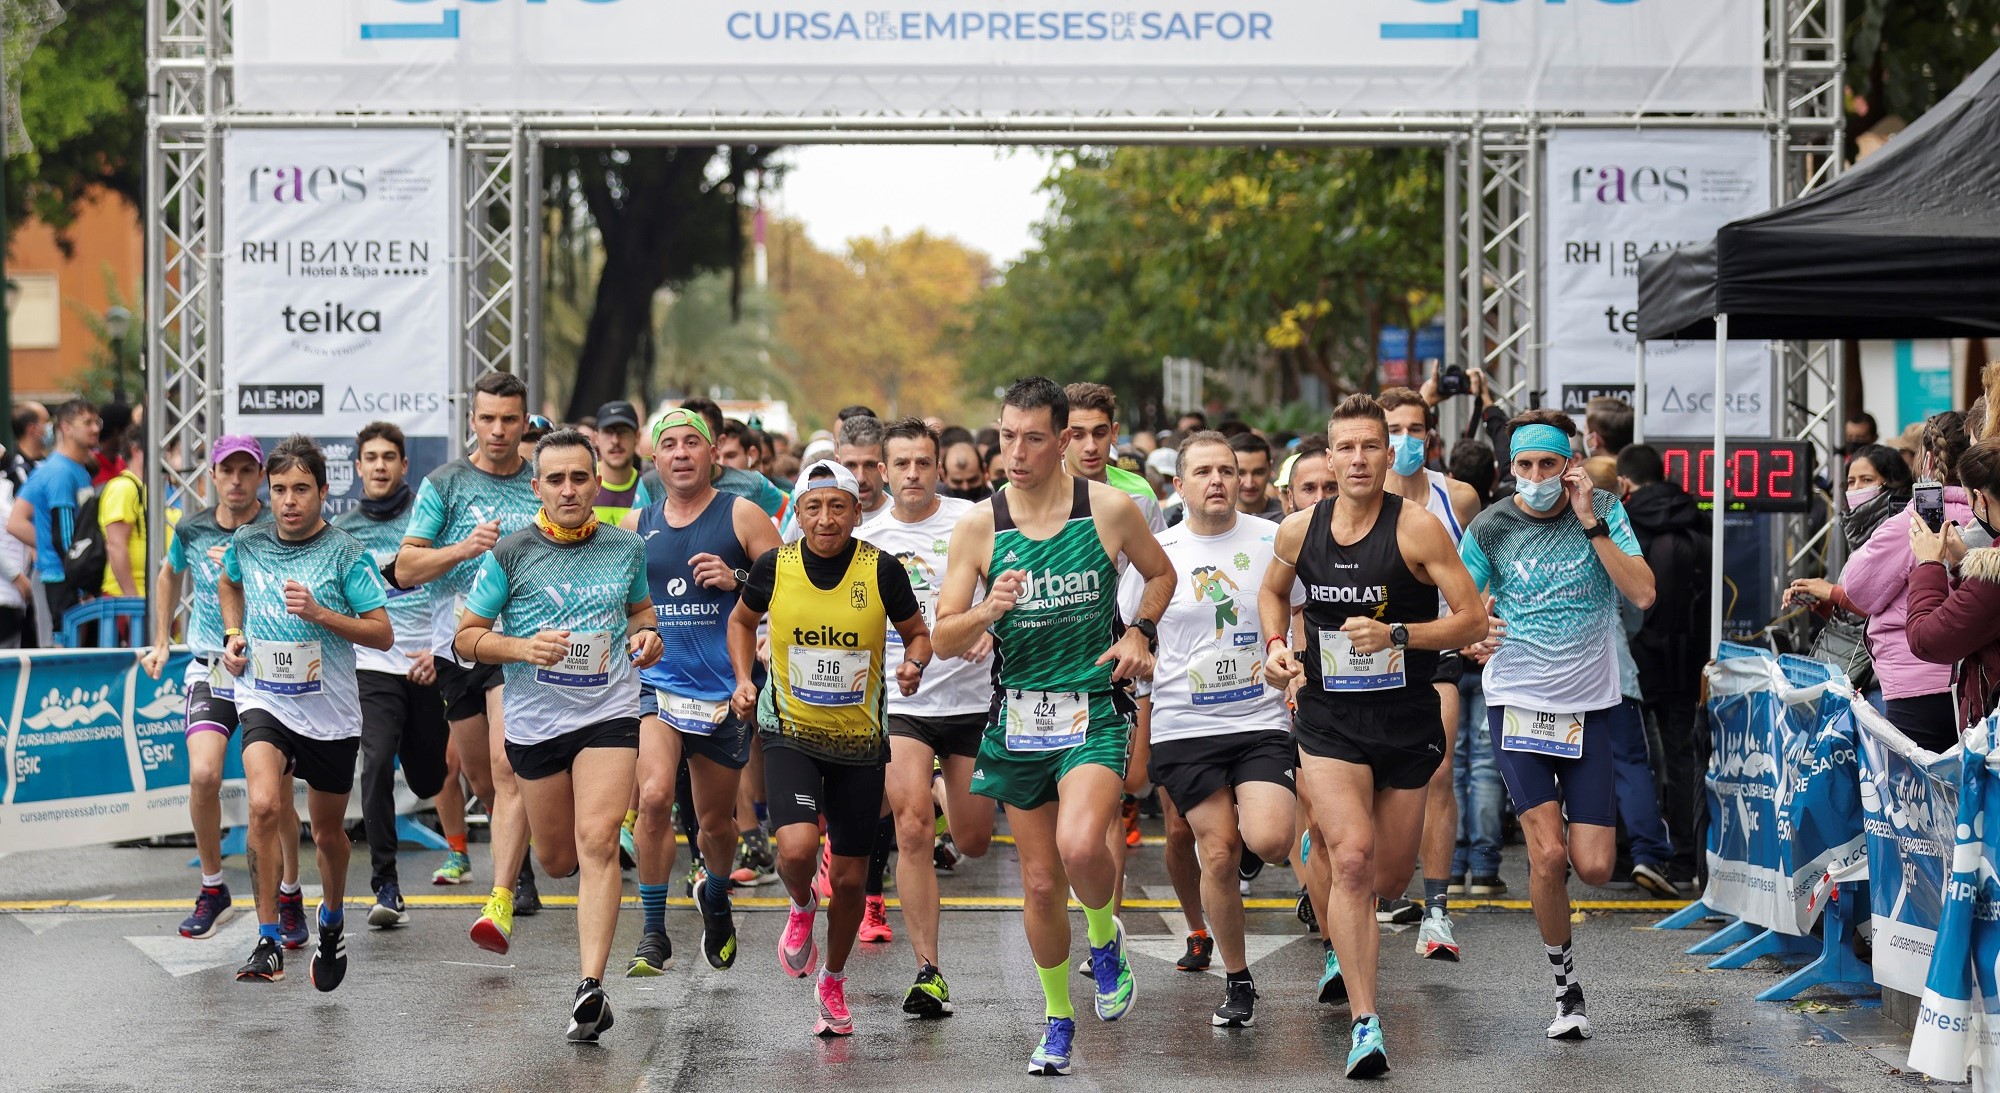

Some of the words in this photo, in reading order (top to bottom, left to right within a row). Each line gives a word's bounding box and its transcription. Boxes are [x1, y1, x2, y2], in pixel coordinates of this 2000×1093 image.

[727, 12, 860, 40] CURSA
[902, 12, 1108, 40] EMPRESES
[1141, 12, 1272, 40] SAFOR
[242, 241, 277, 263] RH
[301, 240, 429, 263] BAYREN
[1566, 241, 1600, 263] RH
[301, 266, 337, 277] Hotel
[340, 266, 349, 277] &
[353, 266, 379, 279] Spa
[282, 302, 381, 333] teika
[241, 389, 320, 410] ALE-HOP
[1661, 385, 1761, 413] ASCRES
[1038, 590, 1100, 610] RUNNERS
[1311, 584, 1383, 603] REDOLAT
[654, 603, 719, 616] ETELGEUX
[1012, 611, 1101, 628] BeUrbanRunning.com
[793, 625, 859, 648] teika
[273, 652, 293, 666] 104
[570, 643, 590, 658] 102
[567, 657, 588, 665] RICARDO
[817, 659, 840, 675] 516
[1216, 659, 1237, 675] 271
[1218, 673, 1237, 682] MANUEL
[681, 702, 701, 711] ALBERTO
[1033, 702, 1056, 717] 424
[18, 732, 45, 747] CURSA
[94, 725, 123, 740] SAFOR
[136, 720, 173, 736] CURSA
[20, 802, 130, 824] cursaempresessafor.com
